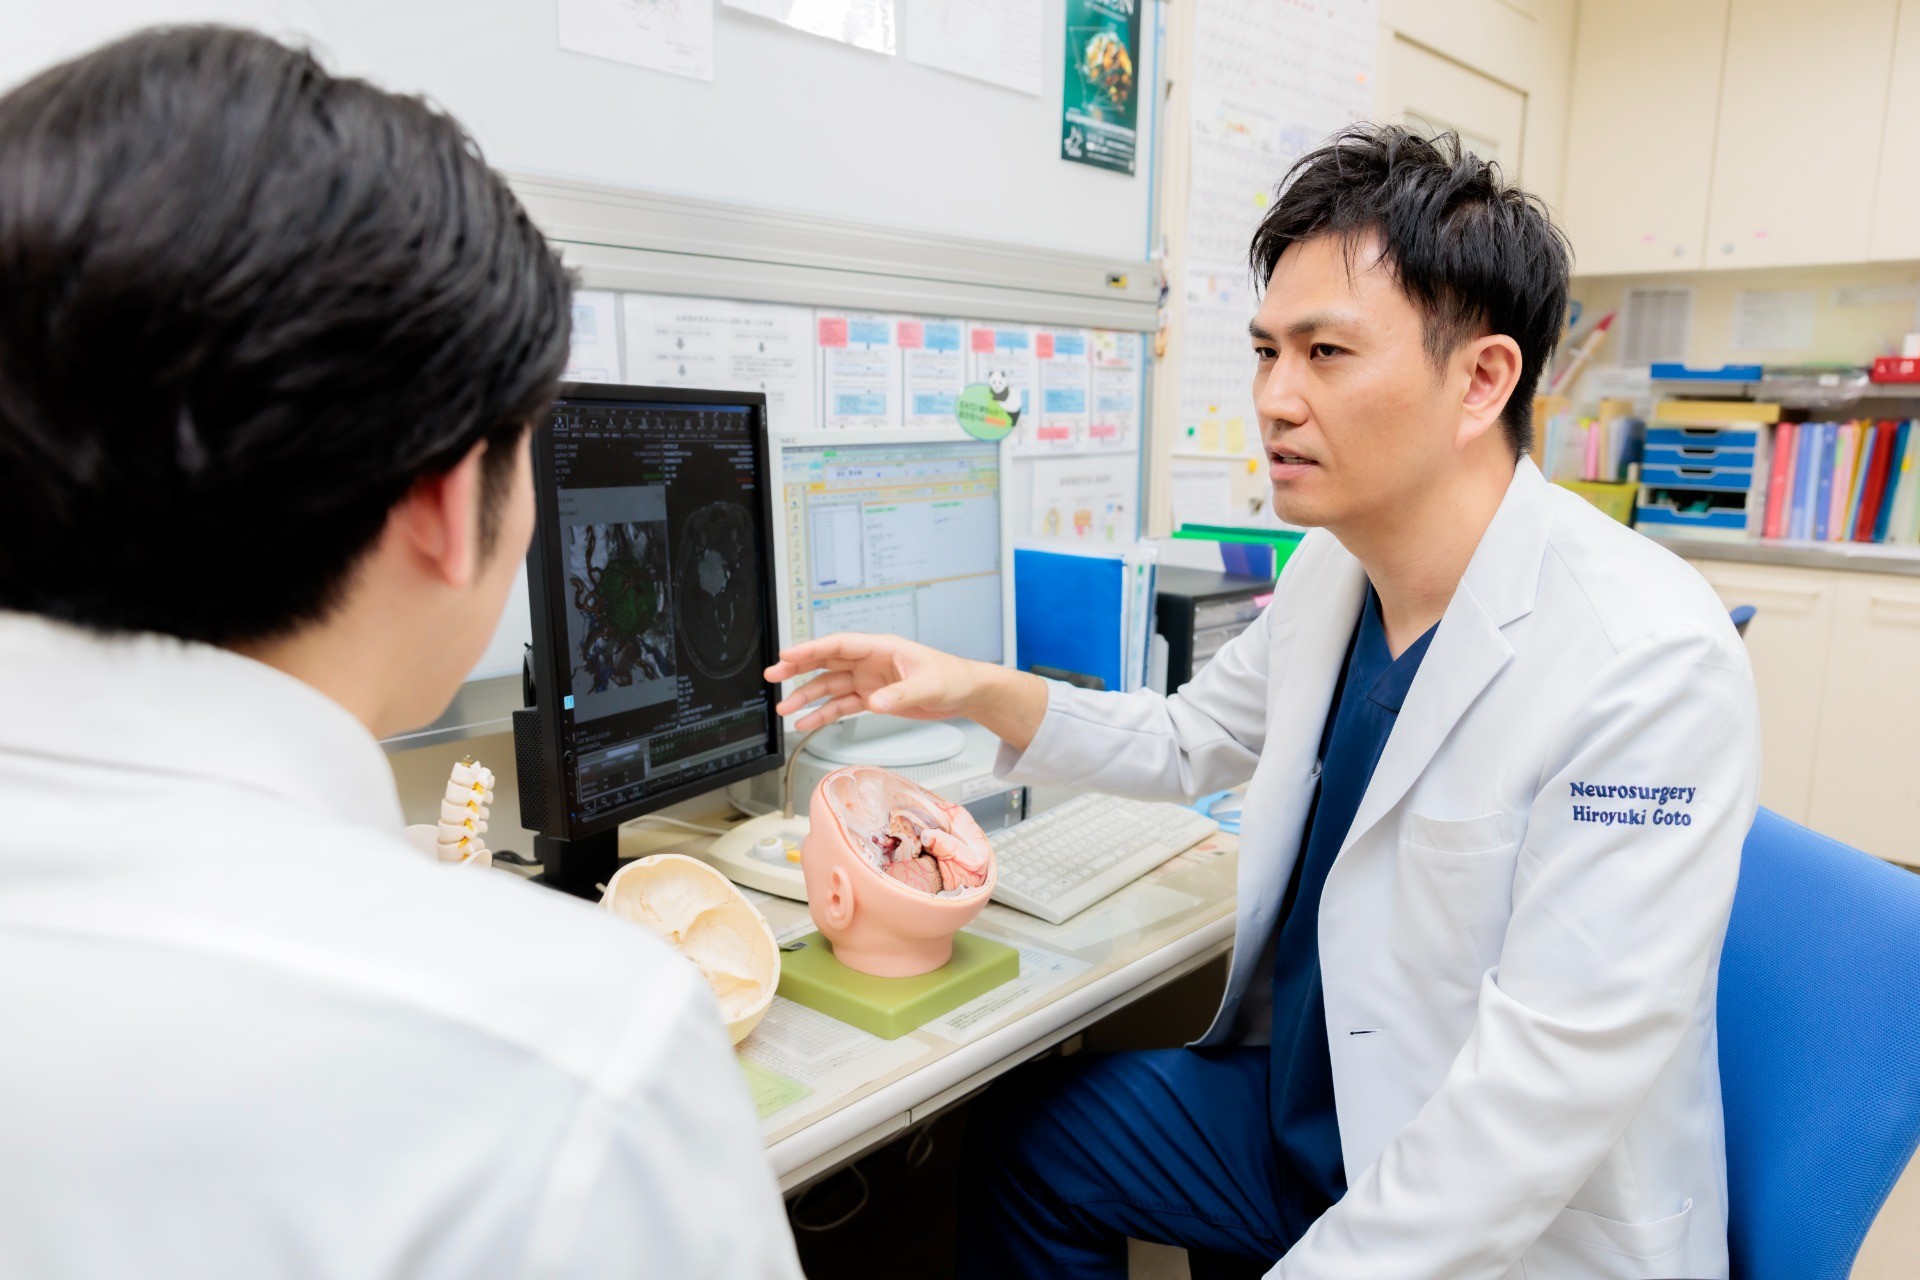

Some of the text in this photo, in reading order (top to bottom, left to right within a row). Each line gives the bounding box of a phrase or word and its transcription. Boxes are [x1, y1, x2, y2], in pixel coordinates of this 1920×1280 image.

[1570, 781, 1696, 805] Neurosurgery
[1573, 805, 1692, 826] Hiroyuki Goto
